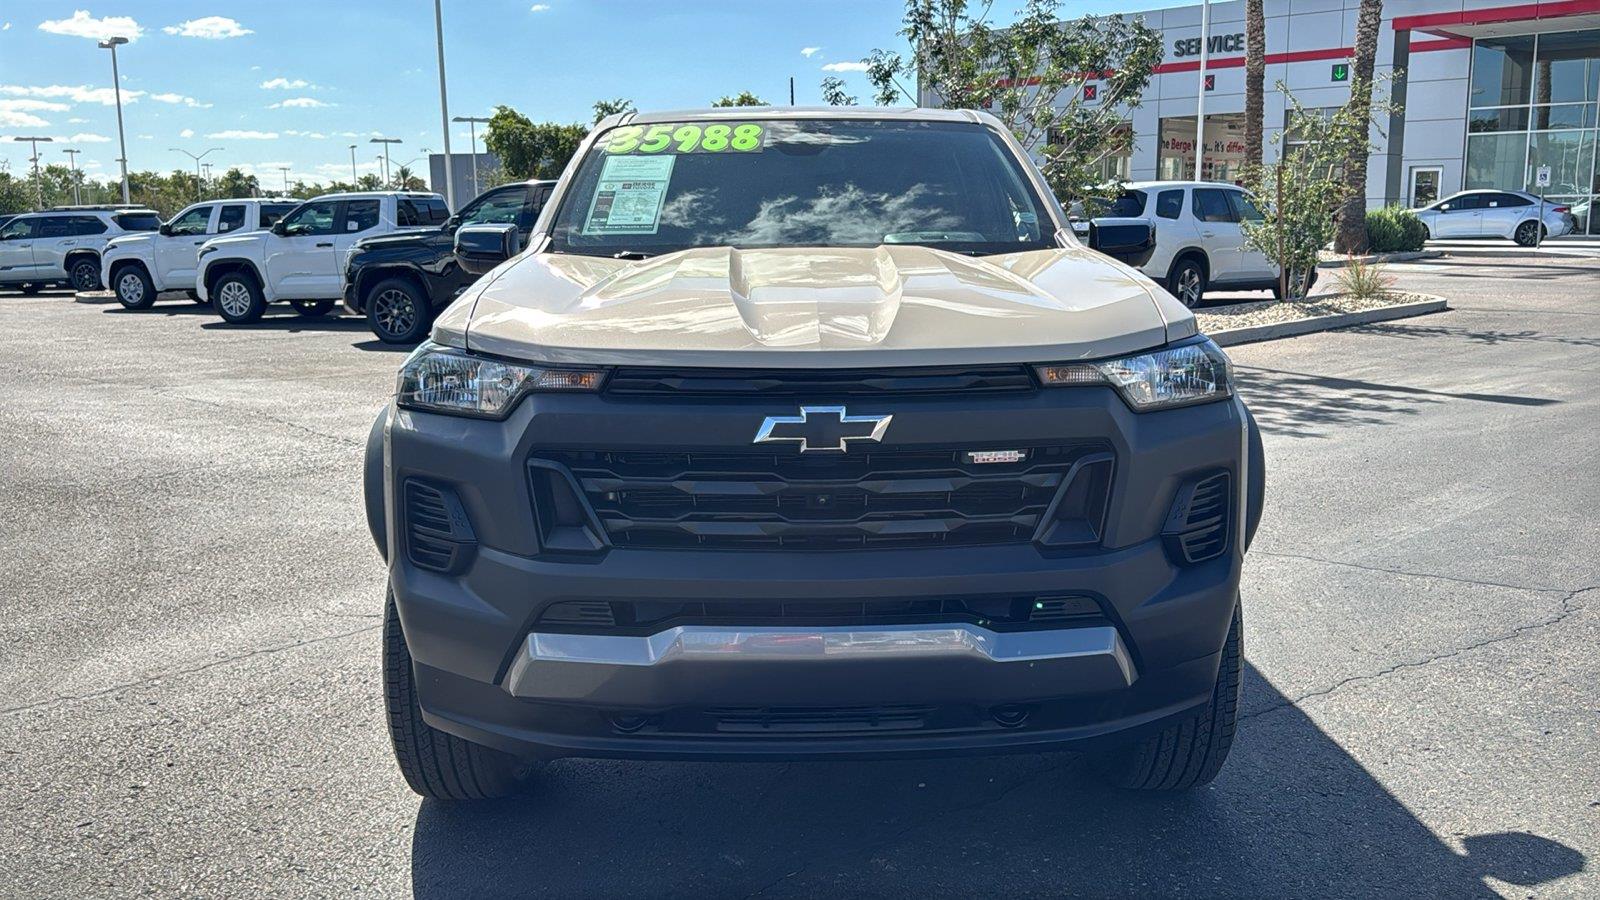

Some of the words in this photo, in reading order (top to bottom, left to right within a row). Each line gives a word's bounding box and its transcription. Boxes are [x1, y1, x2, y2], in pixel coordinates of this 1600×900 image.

[1173, 33, 1245, 57] SERVICE
[606, 123, 764, 154] 35988
[1171, 138, 1191, 154] Berge
[1215, 141, 1225, 152] it's
